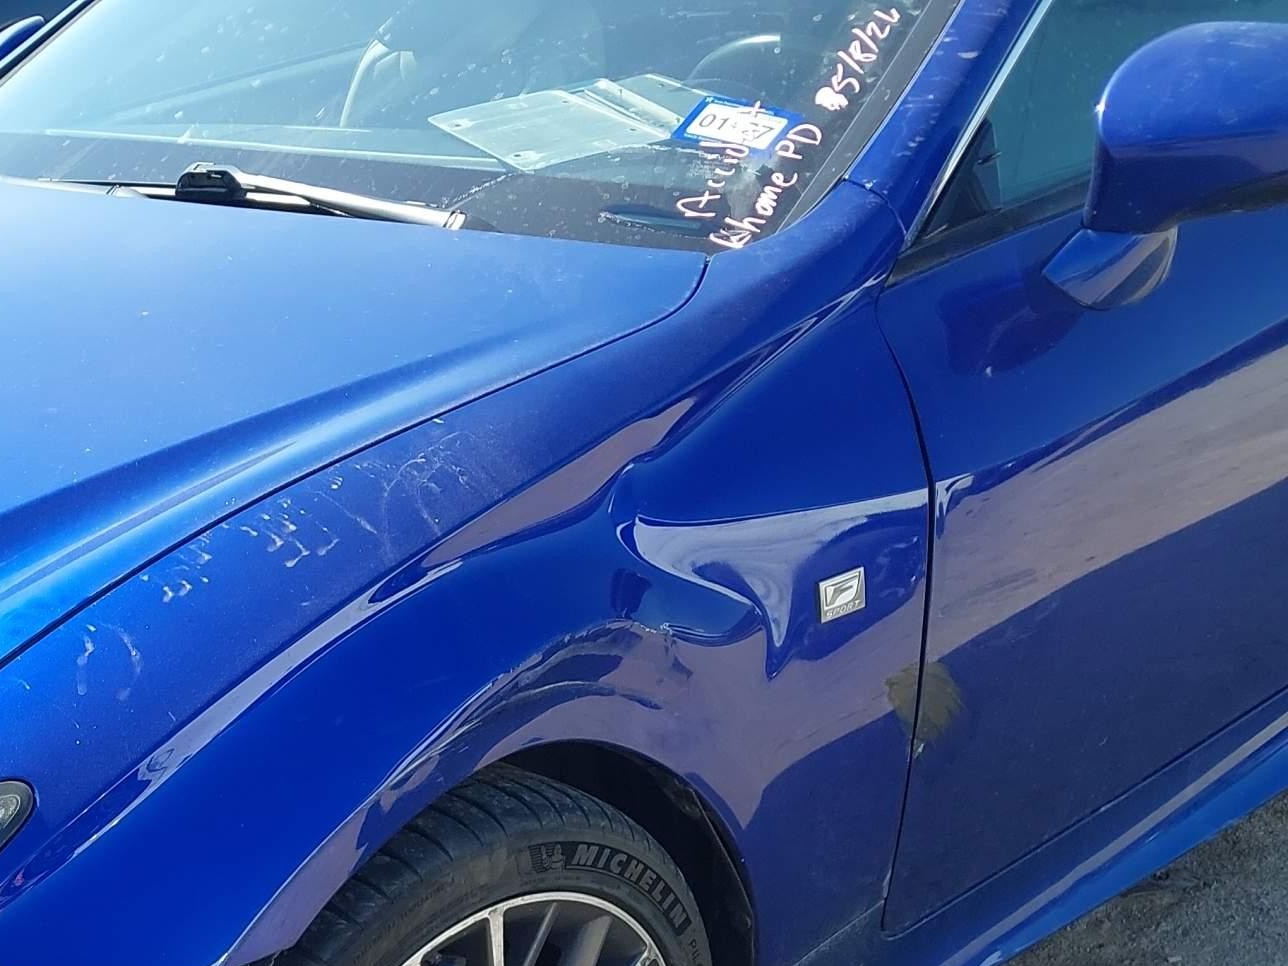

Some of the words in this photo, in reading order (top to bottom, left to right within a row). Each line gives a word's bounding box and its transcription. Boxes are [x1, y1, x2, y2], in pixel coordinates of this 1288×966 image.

[775, 123, 823, 160] PD
[814, 7, 901, 112] 5/8/26
[825, 600, 861, 618] SPORT
[572, 844, 689, 929] MICHELIN
